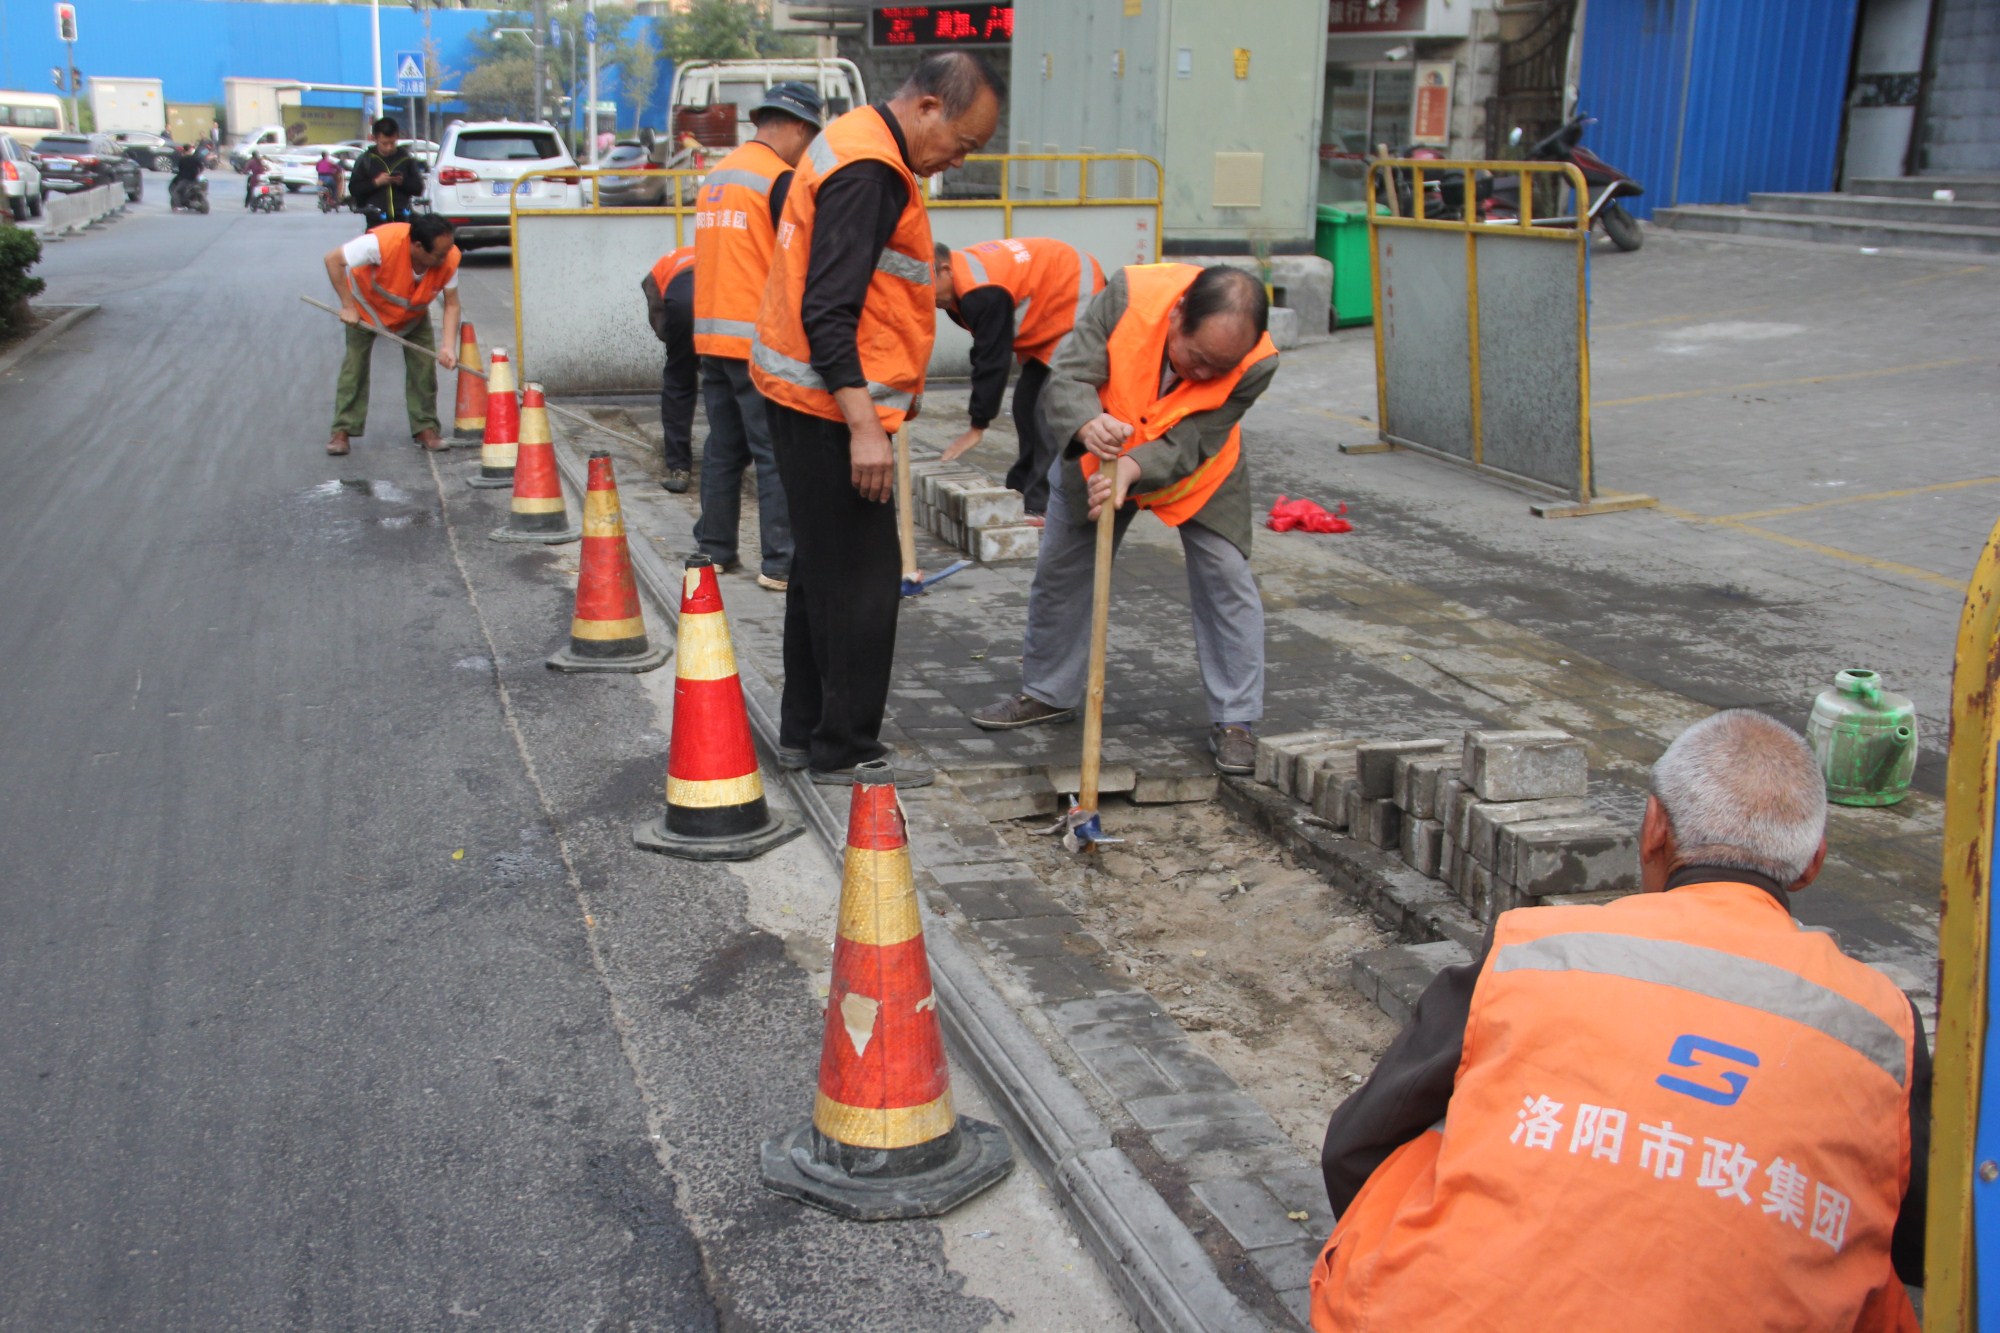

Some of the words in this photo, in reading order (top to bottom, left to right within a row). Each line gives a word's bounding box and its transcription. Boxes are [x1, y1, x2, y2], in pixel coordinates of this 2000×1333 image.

[1509, 1094, 1852, 1253] 洛阳市政集团
